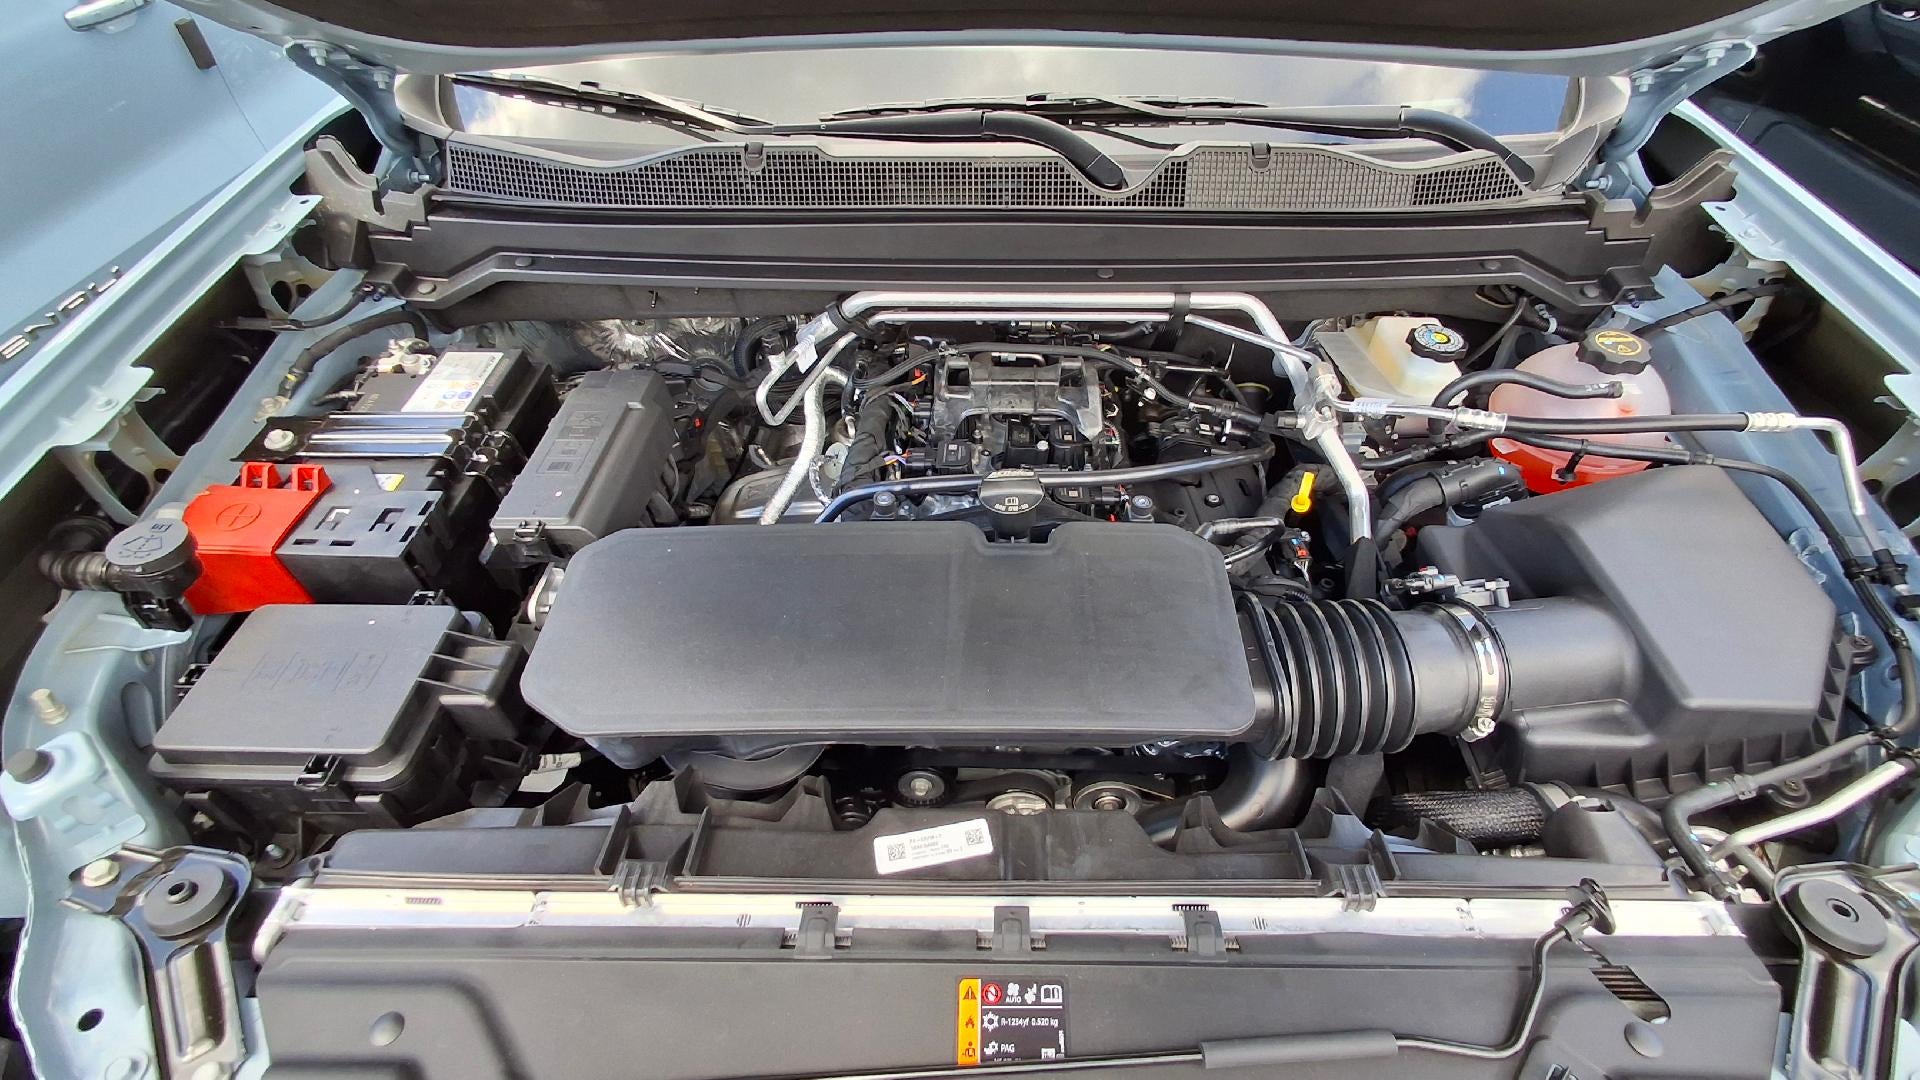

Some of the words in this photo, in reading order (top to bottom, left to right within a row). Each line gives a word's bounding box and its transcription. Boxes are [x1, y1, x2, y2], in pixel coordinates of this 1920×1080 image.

[1001, 1017, 1030, 1028] R-1234yf
[1031, 1017, 1049, 1027] 0.520
[1050, 1017, 1059, 1028] kg
[1000, 1043, 1015, 1053] PAG
